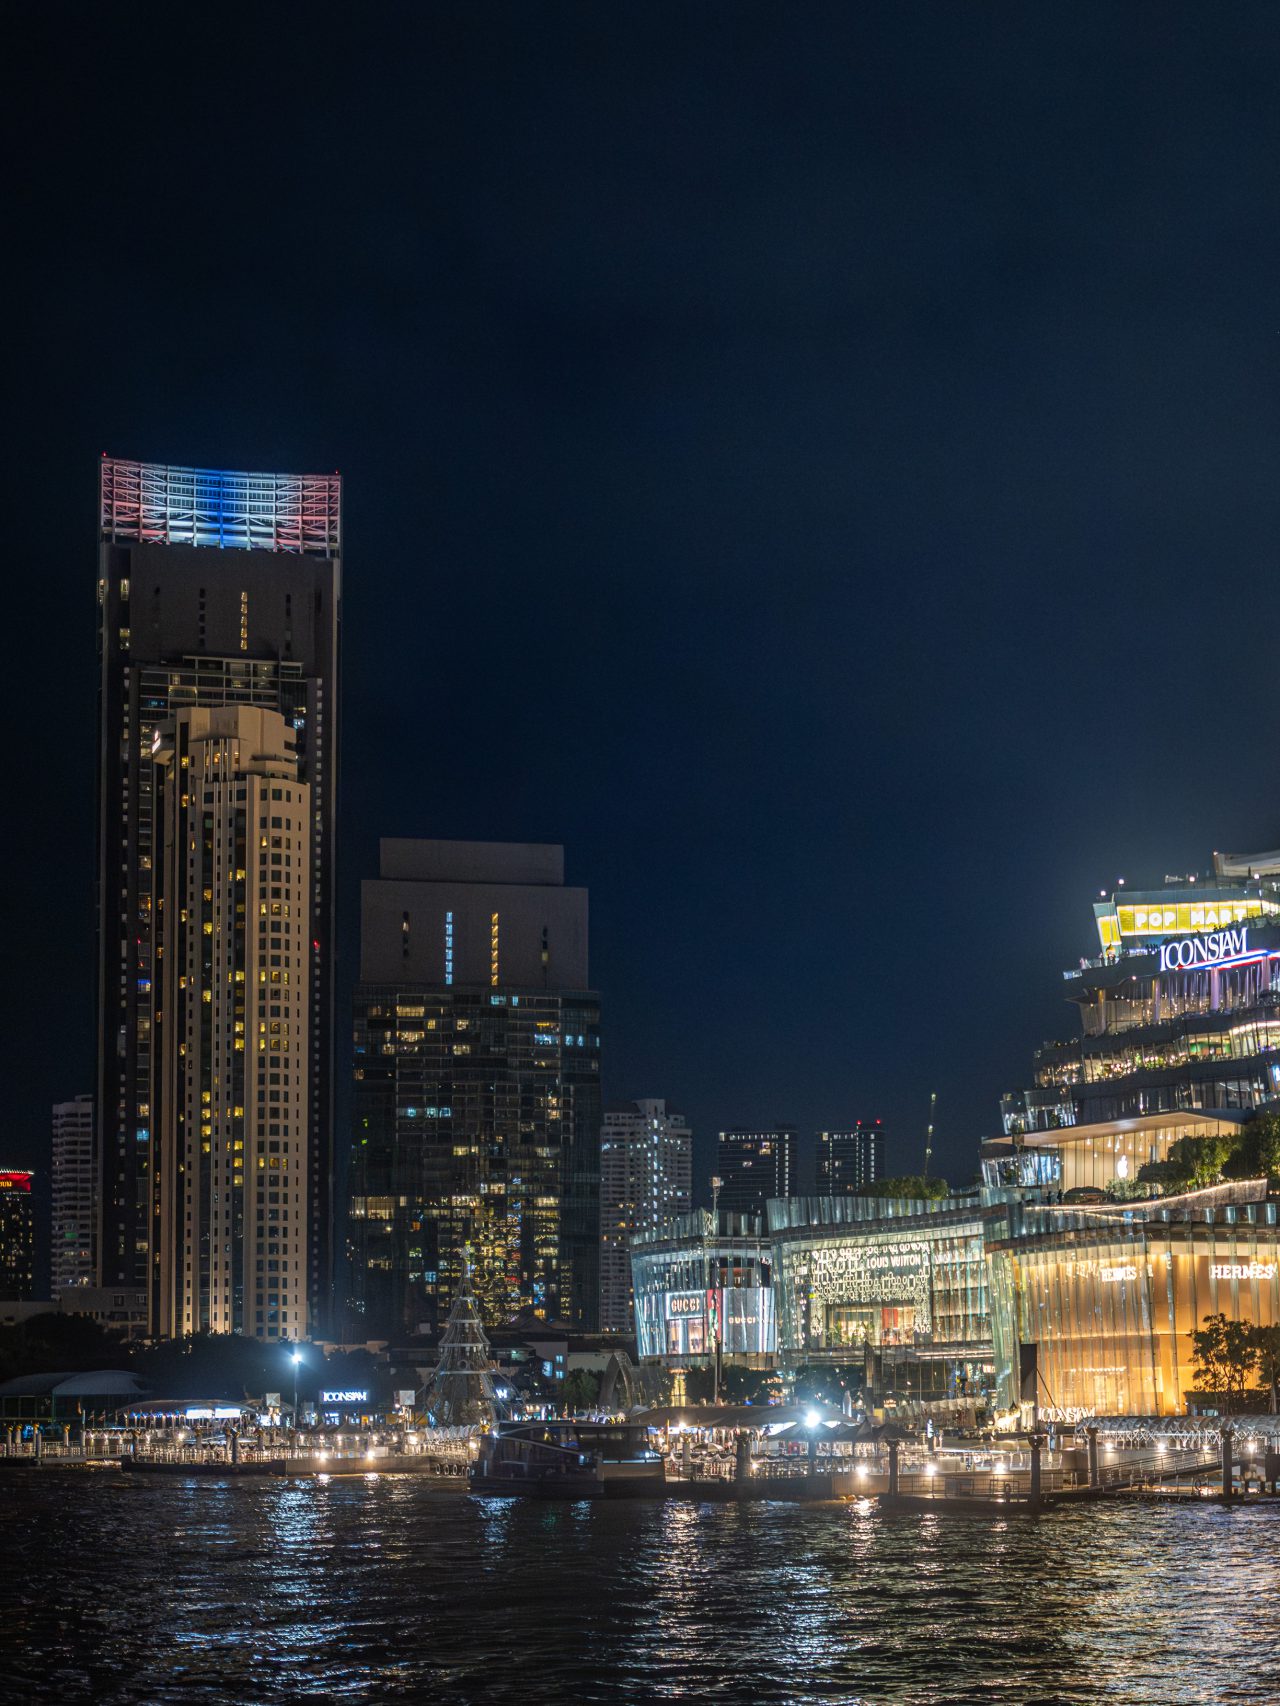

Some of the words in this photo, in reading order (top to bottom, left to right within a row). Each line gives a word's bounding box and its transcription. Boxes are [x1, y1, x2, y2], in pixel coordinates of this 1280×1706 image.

[1135, 911, 1176, 928] POP
[1190, 909, 1247, 926] MART
[1160, 927, 1248, 972] ICONSIAM
[866, 1256, 889, 1269] LOUIS
[890, 1253, 921, 1267] VUITTON
[671, 1298, 700, 1313] GUCCI
[728, 1316, 756, 1324] GUCCI
[323, 1391, 368, 1402] ICONSIAM
